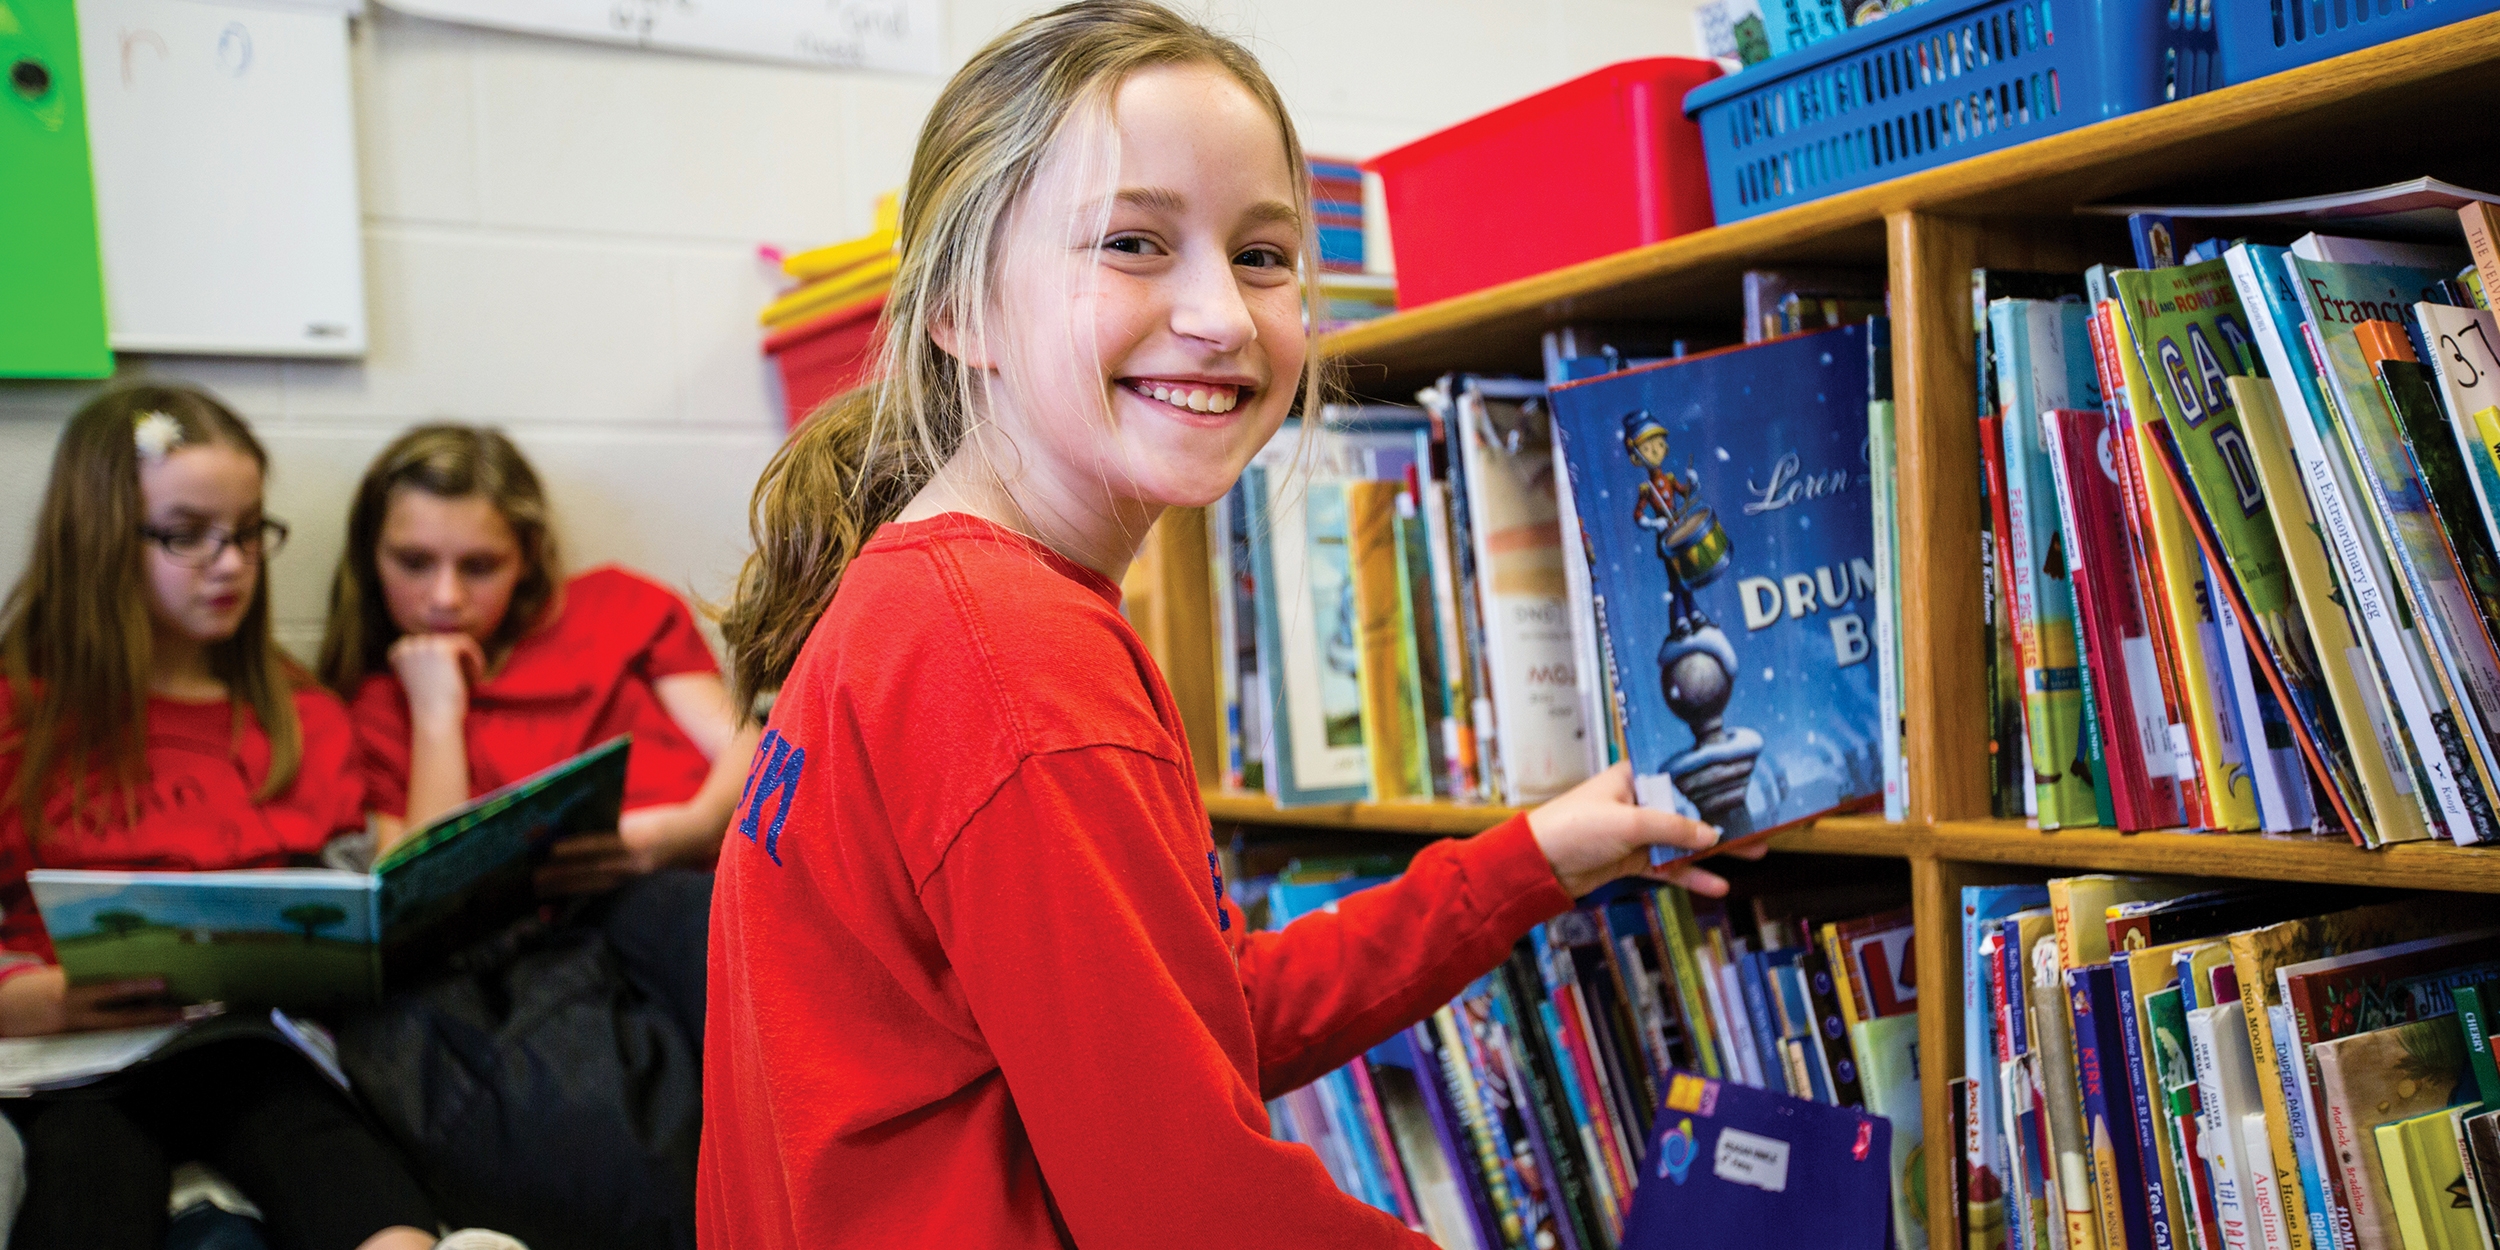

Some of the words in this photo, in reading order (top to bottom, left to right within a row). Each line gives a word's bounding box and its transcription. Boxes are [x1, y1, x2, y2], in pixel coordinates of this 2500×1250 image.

[2469, 226, 2490, 257] THE
[2173, 284, 2234, 314] RONDE
[1743, 453, 1847, 515] Loren
[2310, 458, 2325, 481] An
[2320, 481, 2368, 585] Extraordinary
[2361, 587, 2381, 620] Egg
[2441, 786, 2461, 816] Knopf
[2118, 989, 2132, 1014] Kelly
[2280, 984, 2289, 999] Eric
[2241, 982, 2255, 1013] INGA
[2248, 1016, 2265, 1064] MOORE
[2283, 1001, 2294, 1022] Carle
[2294, 1006, 2309, 1037] JAN
[2121, 1016, 2138, 1055] Starling
[2462, 1010, 2486, 1055] CHERRY
[2080, 1047, 2103, 1096] KIRK
[2128, 1055, 2143, 1086] Lyons
[2201, 1043, 2211, 1070] DREW
[2275, 1040, 2294, 1089] TOMPERT
[2287, 1097, 2304, 1137] PARKER
[2208, 1092, 2223, 1127] OLIVER
[2139, 1118, 2153, 1148] Lewis
[2278, 1167, 2289, 1178] A
[2330, 1104, 2350, 1146] Morlock
[2345, 1164, 2369, 1215] Bradshaw
[2097, 1159, 2117, 1205] LIBRARY
[2146, 1181, 2165, 1214] Tea
[2217, 1178, 2239, 1212] THE
[2251, 1169, 2281, 1242] Angelina
[2281, 1183, 2299, 1229] House
[2322, 1185, 2334, 1215] HOUSE
[2329, 1216, 2338, 1234] FOR
[2104, 1209, 2123, 1248] MOUSE
[2222, 1216, 2248, 1250] DAY
[2291, 1233, 2303, 1248] in
